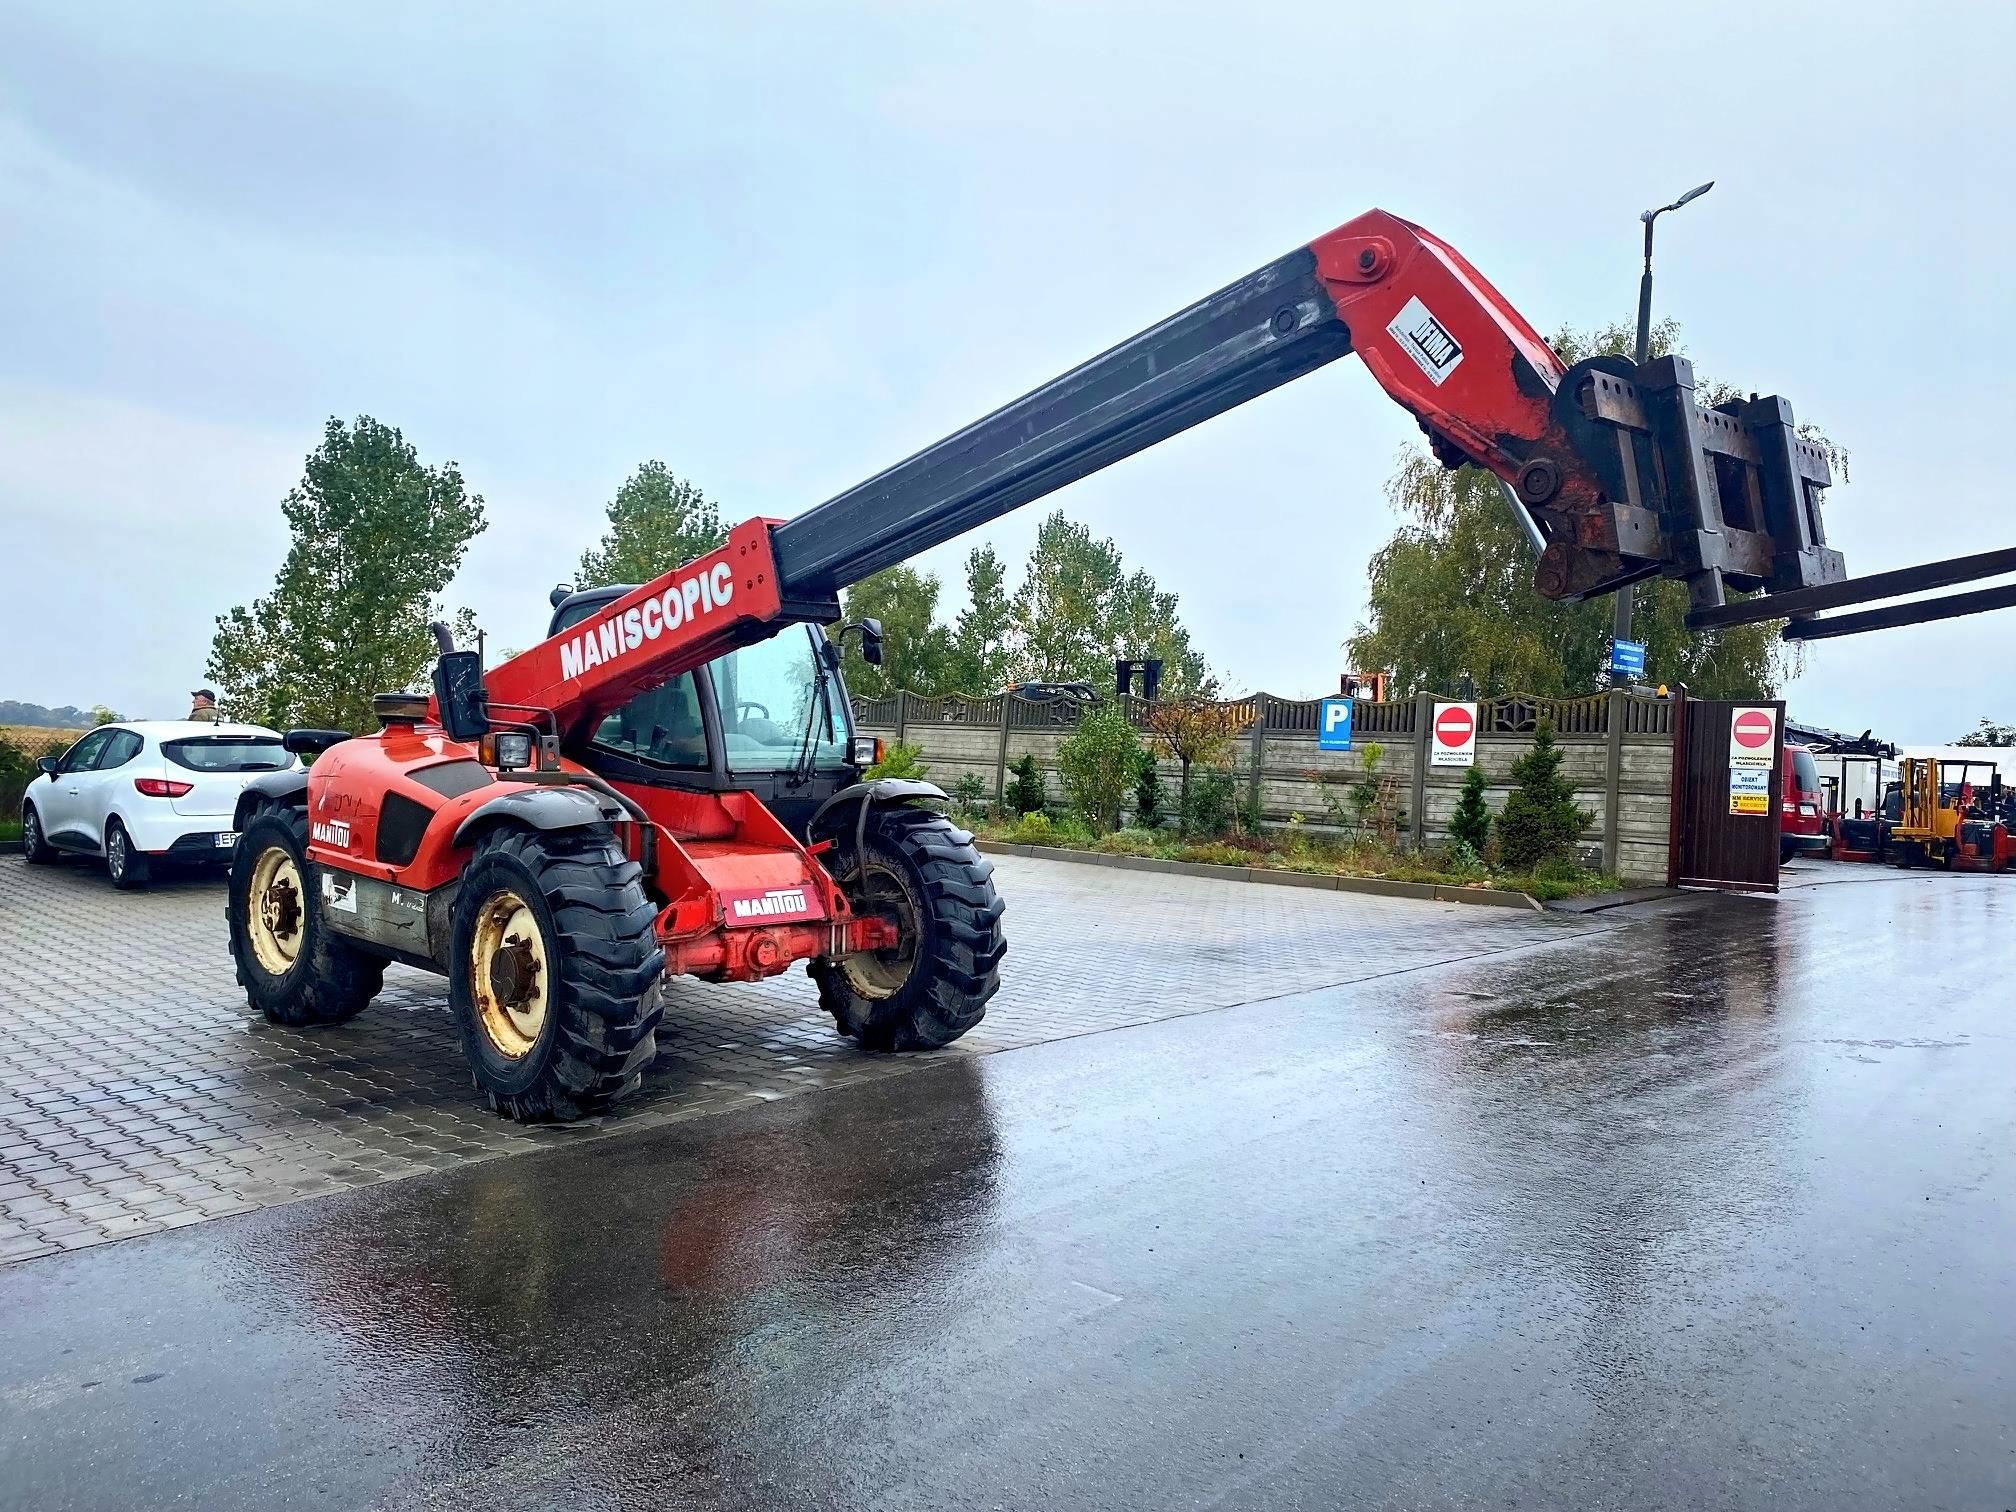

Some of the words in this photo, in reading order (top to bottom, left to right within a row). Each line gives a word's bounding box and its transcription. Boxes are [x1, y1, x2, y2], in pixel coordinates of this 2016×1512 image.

[560, 562, 734, 681] MANISCOPIC
[1326, 704, 1348, 732] P
[312, 819, 350, 849] MANITOU
[733, 889, 807, 918] MANITOU
